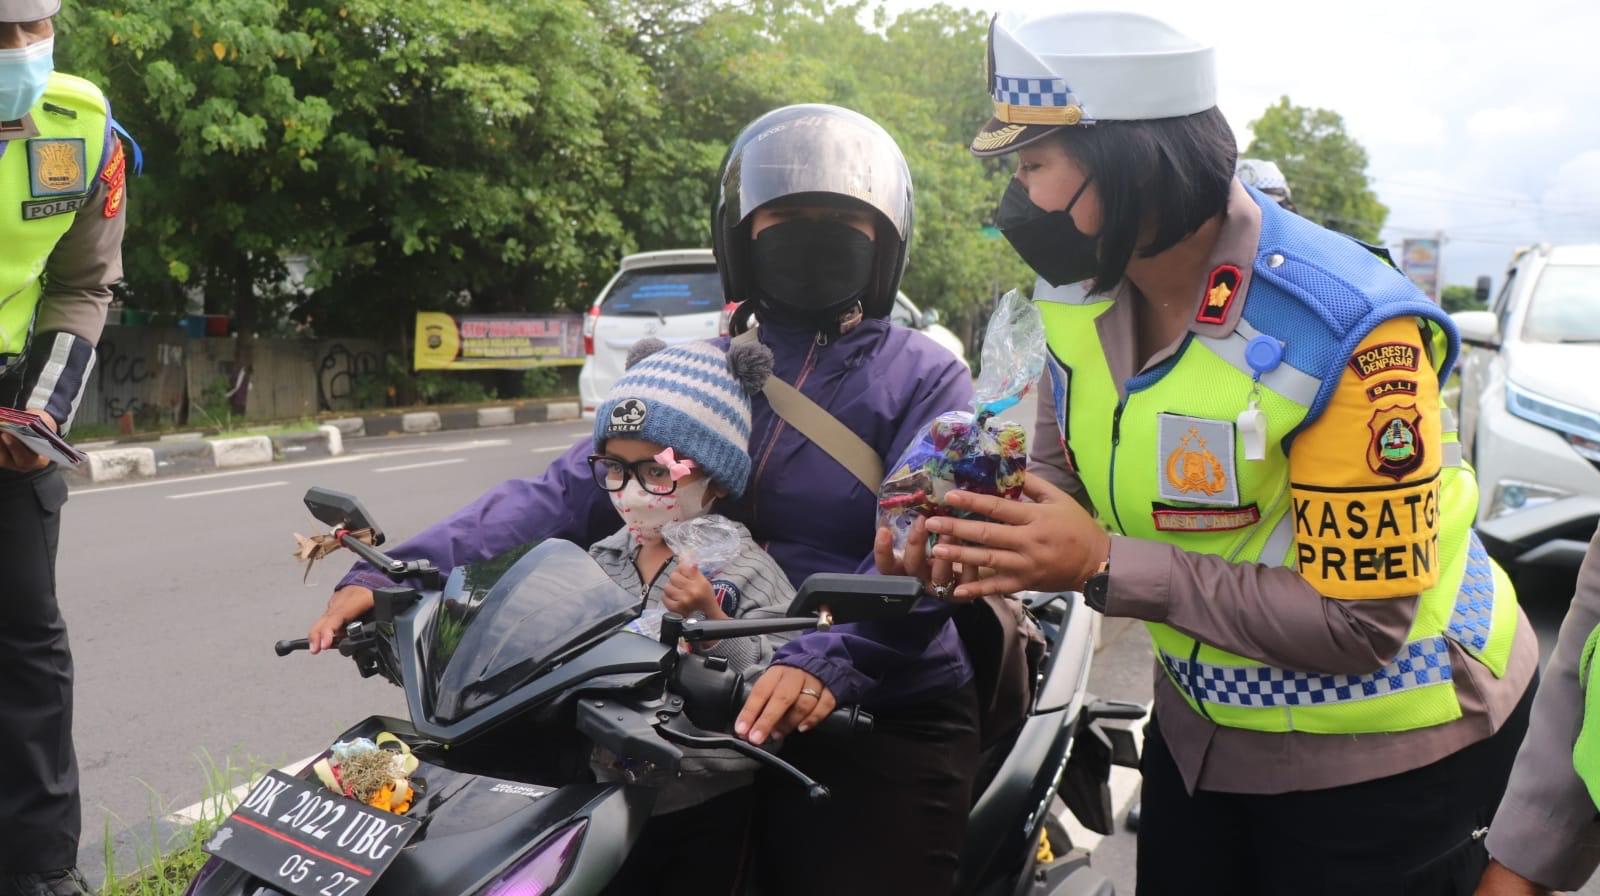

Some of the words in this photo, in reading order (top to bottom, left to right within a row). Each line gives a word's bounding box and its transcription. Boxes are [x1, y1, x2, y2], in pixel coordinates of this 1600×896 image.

[1357, 346, 1414, 368] POLRESTA
[1362, 357, 1413, 375] DENPASAR
[1374, 382, 1411, 396] BALI
[243, 775, 293, 817] DK
[277, 789, 347, 840] 2022
[336, 811, 404, 860] UBG
